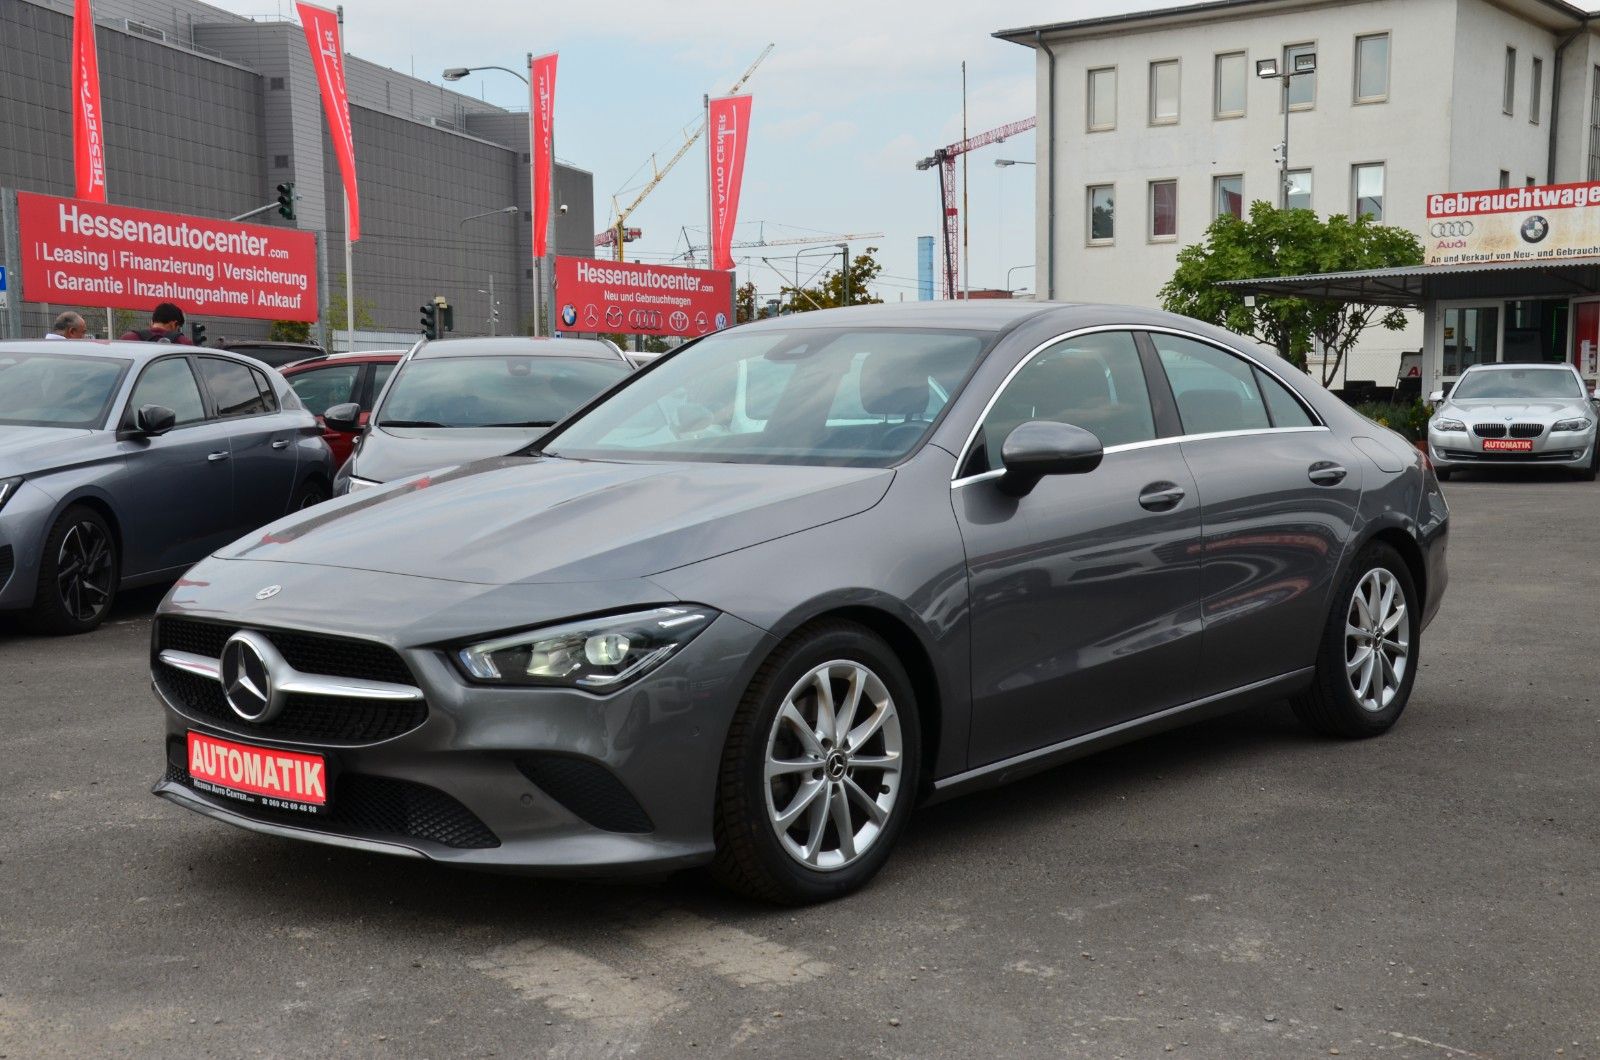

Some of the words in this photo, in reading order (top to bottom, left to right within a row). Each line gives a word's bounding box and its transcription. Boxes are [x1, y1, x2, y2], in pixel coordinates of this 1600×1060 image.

[86, 103, 104, 186] HESSEN
[43, 242, 109, 271] Leasing
[119, 251, 214, 281] Finanzierung
[223, 262, 307, 290] Versicherung
[1431, 255, 1442, 264] An
[1444, 254, 1458, 263] und
[1461, 252, 1493, 262] Verkauf
[1496, 252, 1511, 260] von
[1513, 250, 1534, 259] Neu-
[1538, 248, 1554, 258] und
[54, 271, 123, 295] Garantie
[133, 278, 248, 306] Inzahlungnahme
[257, 290, 302, 309] Ankauf
[604, 290, 619, 301] Neu
[620, 291, 634, 302] und
[635, 292, 692, 307] Gebrauchtwagen
[1483, 440, 1532, 449] AUTOMATIK
[191, 739, 325, 798] AUTOMATIK
